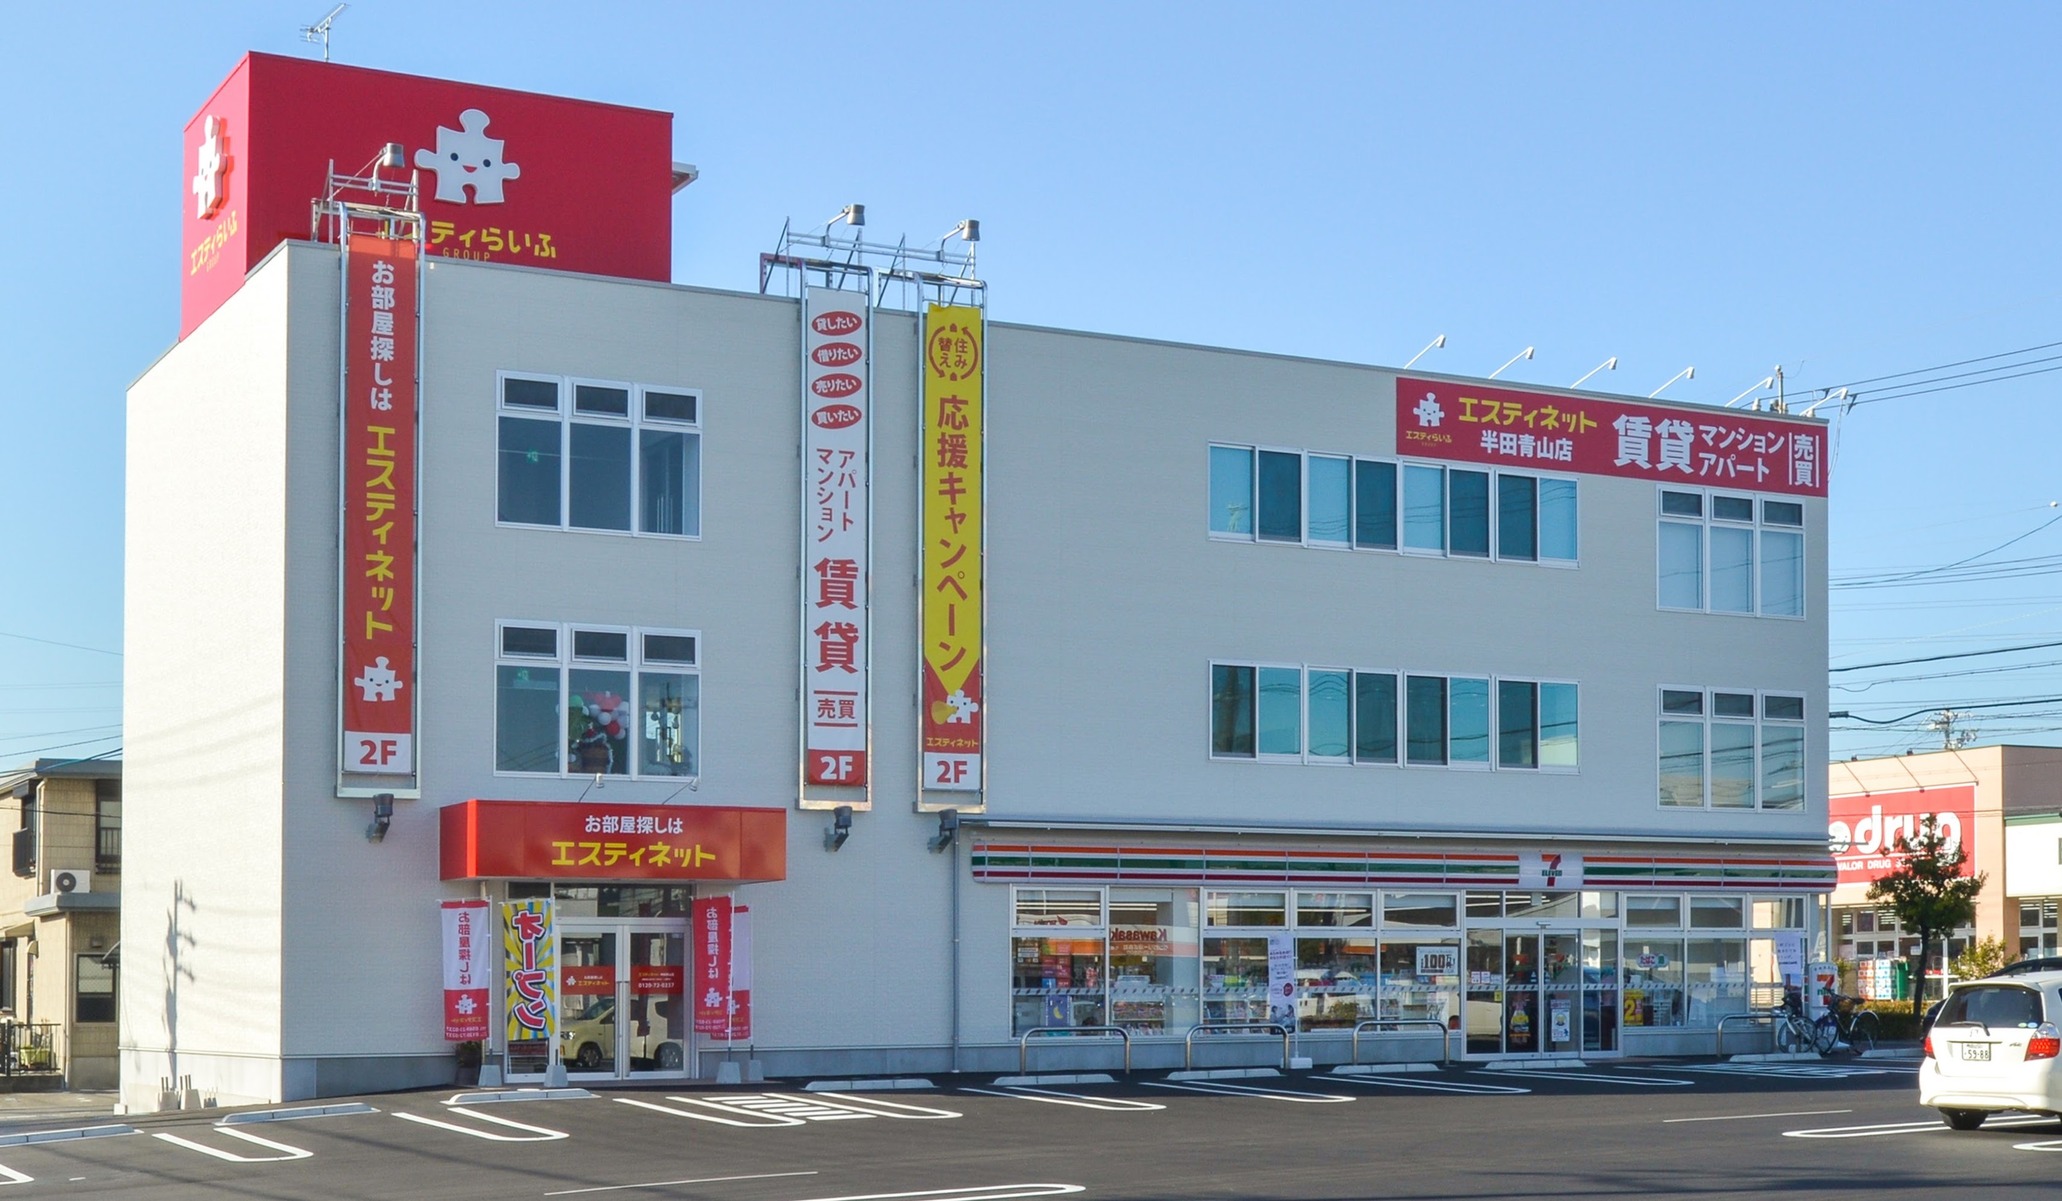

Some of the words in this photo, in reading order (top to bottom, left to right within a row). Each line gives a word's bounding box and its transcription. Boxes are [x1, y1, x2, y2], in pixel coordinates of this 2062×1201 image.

[190, 210, 238, 276] エスティらいふ
[384, 219, 556, 259] ティらいふ
[443, 247, 491, 262] GROUP
[371, 260, 395, 411] お部屋探しは
[816, 315, 858, 331] 貸したい
[816, 346, 859, 363] 借りたい
[816, 377, 858, 394] 売りたい
[816, 408, 859, 425] 買いたい
[1458, 397, 1598, 434] エスティネット
[1406, 430, 1453, 443] エスティらいふ
[1480, 429, 1573, 462] 半田青山店
[1612, 413, 1695, 475] 賃貸
[1699, 424, 1785, 454] マンション
[1699, 452, 1770, 483] アパート
[1794, 433, 1814, 488] 売買
[816, 448, 834, 543] マンション
[838, 449, 856, 531] アパート
[365, 425, 396, 640] エスティネット
[937, 395, 969, 672] 応援キャンペーン
[814, 557, 859, 674] 賃貸
[817, 698, 856, 720] 売買
[359, 740, 398, 765] 2F
[926, 737, 979, 748] エスティネット
[820, 755, 853, 780] 2F
[937, 760, 968, 784] 2F
[585, 815, 684, 834] お部屋探しは
[551, 841, 716, 868] エスティネット
[1867, 860, 1892, 870] DRUG
[1542, 854, 1561, 887] 7
